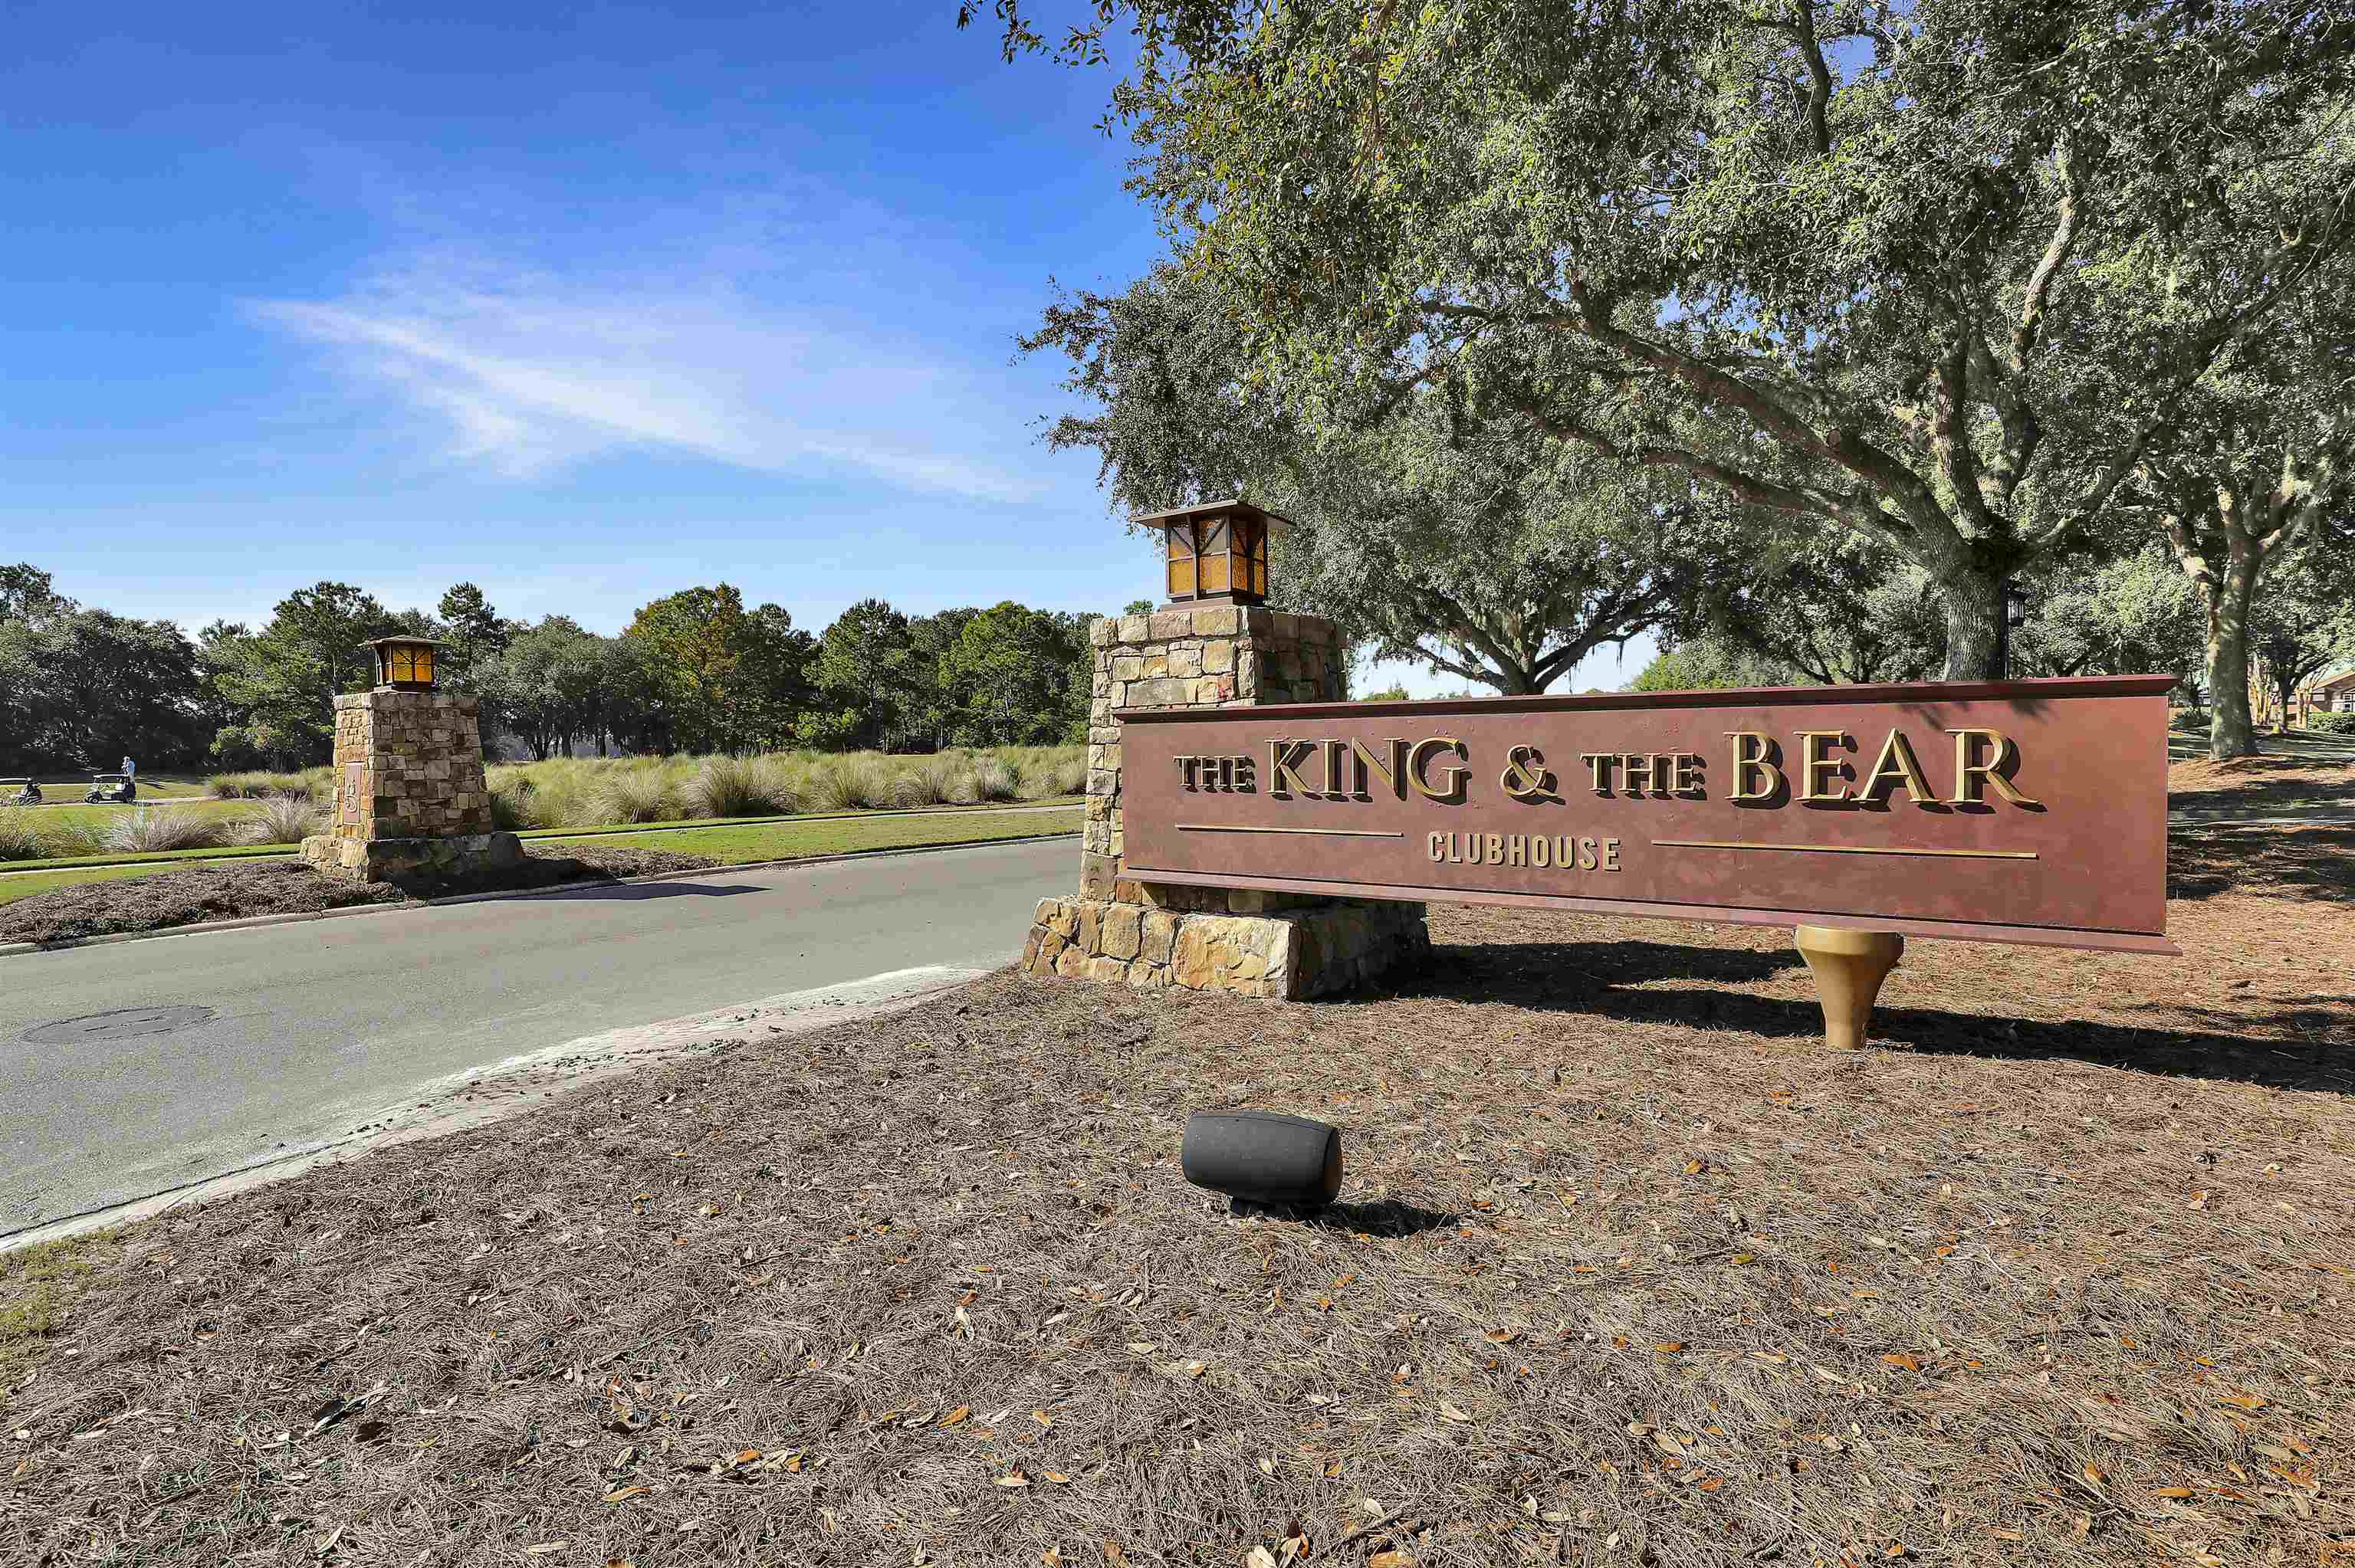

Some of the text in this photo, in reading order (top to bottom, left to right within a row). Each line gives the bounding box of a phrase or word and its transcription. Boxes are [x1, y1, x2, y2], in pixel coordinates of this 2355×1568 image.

[1172, 727, 2041, 807] THE KING & THE BEAR
[1427, 831, 1621, 871] CLUBHOUSE
